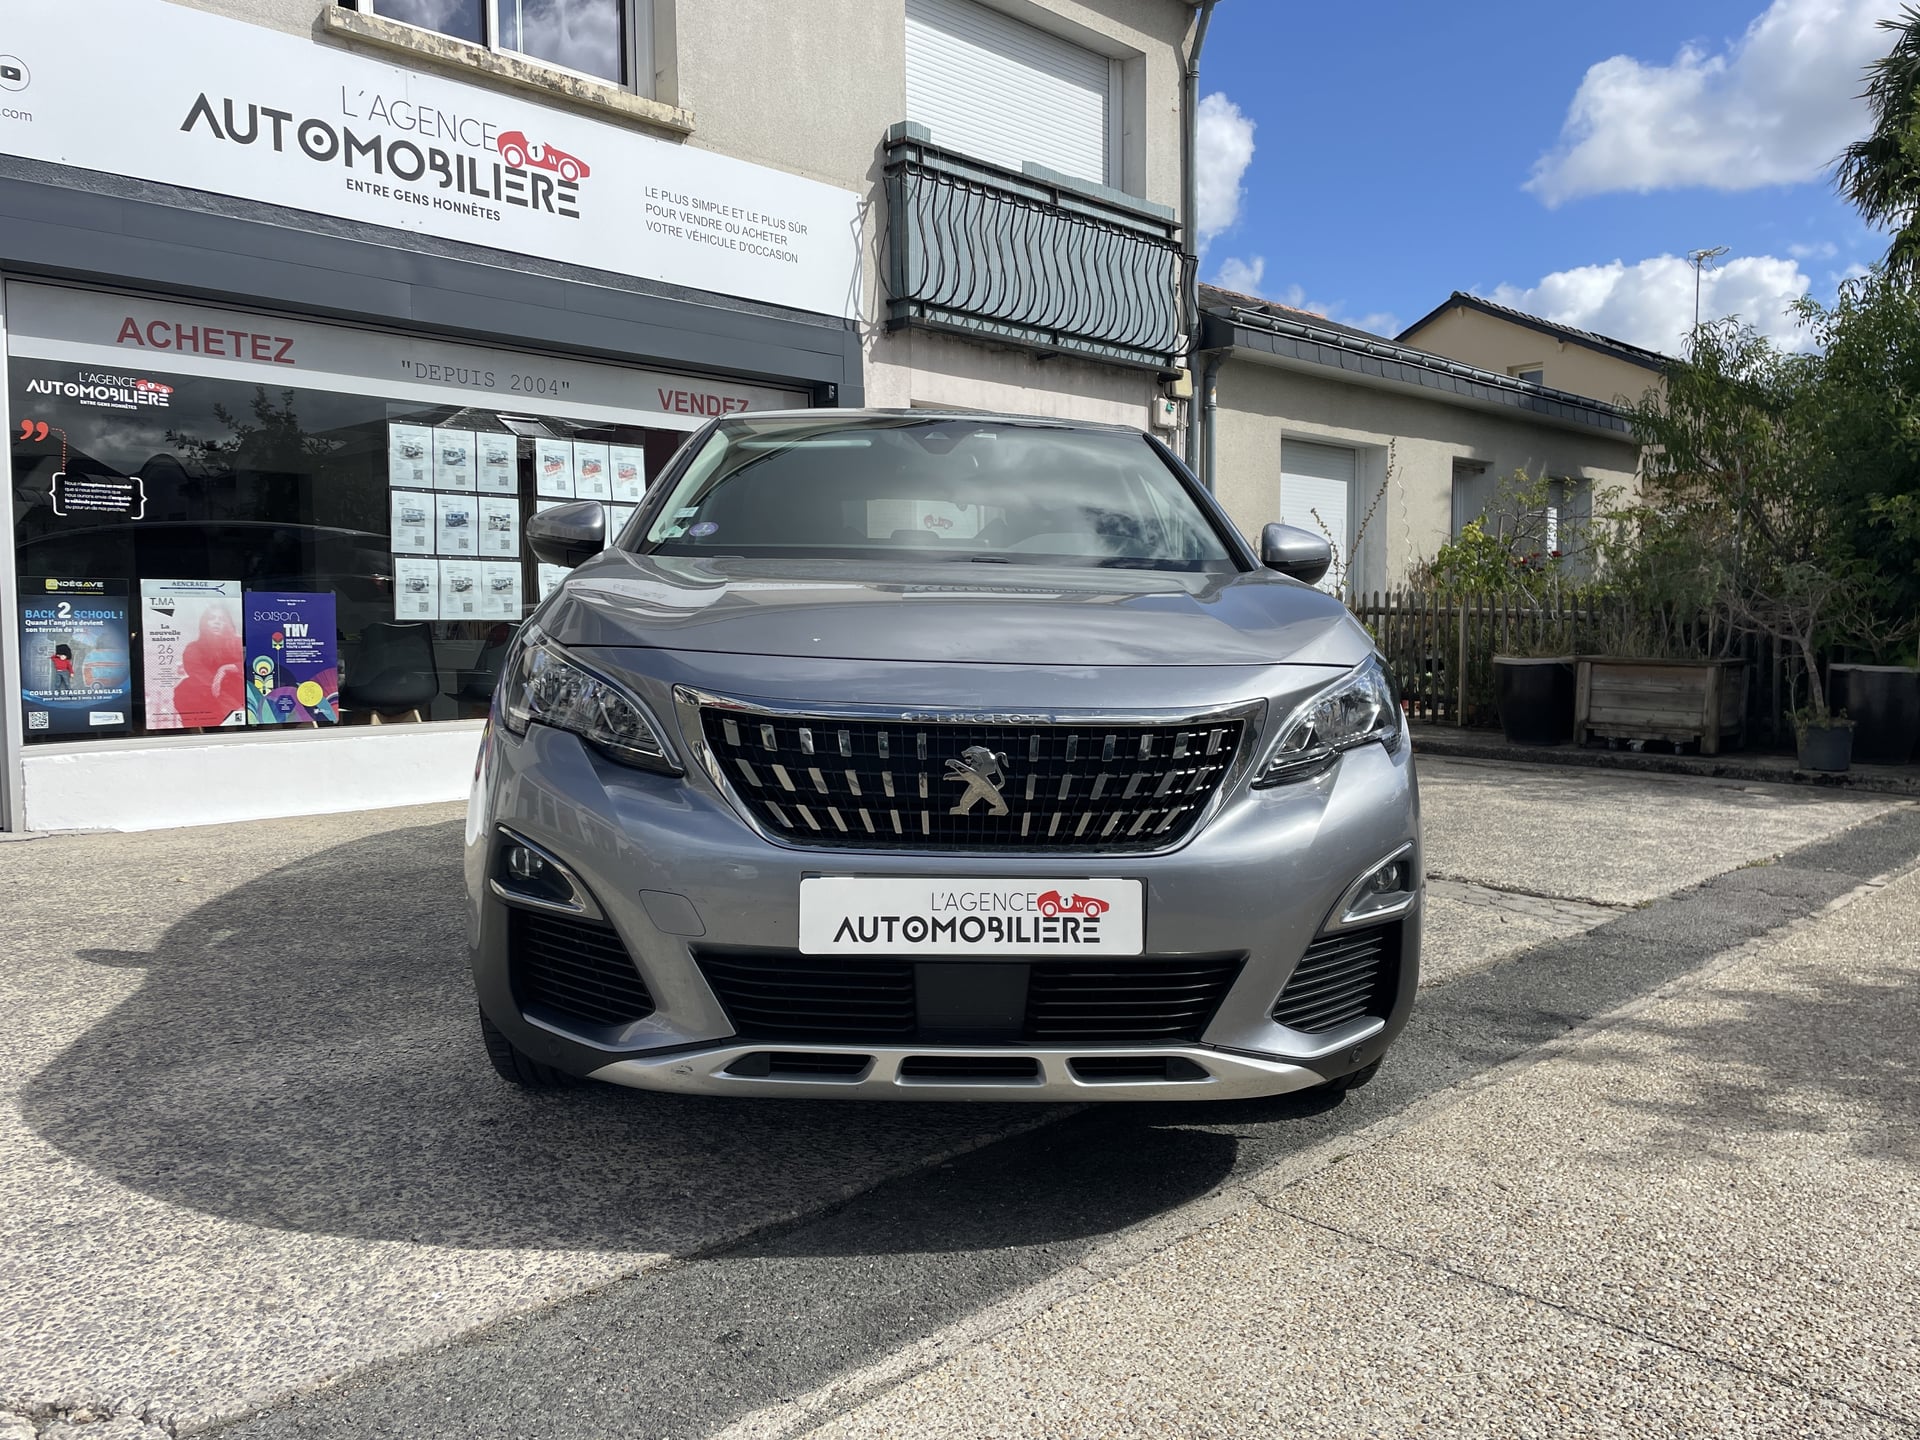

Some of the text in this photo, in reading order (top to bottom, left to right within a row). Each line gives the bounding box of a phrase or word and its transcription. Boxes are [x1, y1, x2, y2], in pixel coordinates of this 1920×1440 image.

[341, 85, 498, 152] L'AGENCE
[532, 145, 538, 158] 1
[346, 178, 501, 222] ENTRE GENS HONNÊTES
[644, 185, 808, 236] LE PLUS SIMPLE ET LE PLUS SÛR
[645, 202, 788, 246] POUR VENDRE OU ACHETER
[645, 219, 799, 264] VOTRE VÉHICULE D'OCCASION
[116, 316, 296, 365] ACHETEZ
[78, 371, 136, 388] L'AGENCE
[401, 359, 571, 396] "DEPUIS 2004"
[25, 609, 56, 619] BACK
[57, 601, 72, 619] 2
[73, 610, 118, 619] SCHOOL
[25, 619, 48, 627] Quand
[48, 619, 78, 627] l'anglais
[283, 623, 309, 637] THV
[157, 644, 174, 655] 26
[158, 655, 174, 666] 27
[918, 713, 1040, 725] PEUGEOT
[930, 891, 1038, 912] L'AGENCE
[1063, 897, 1069, 906] 1
